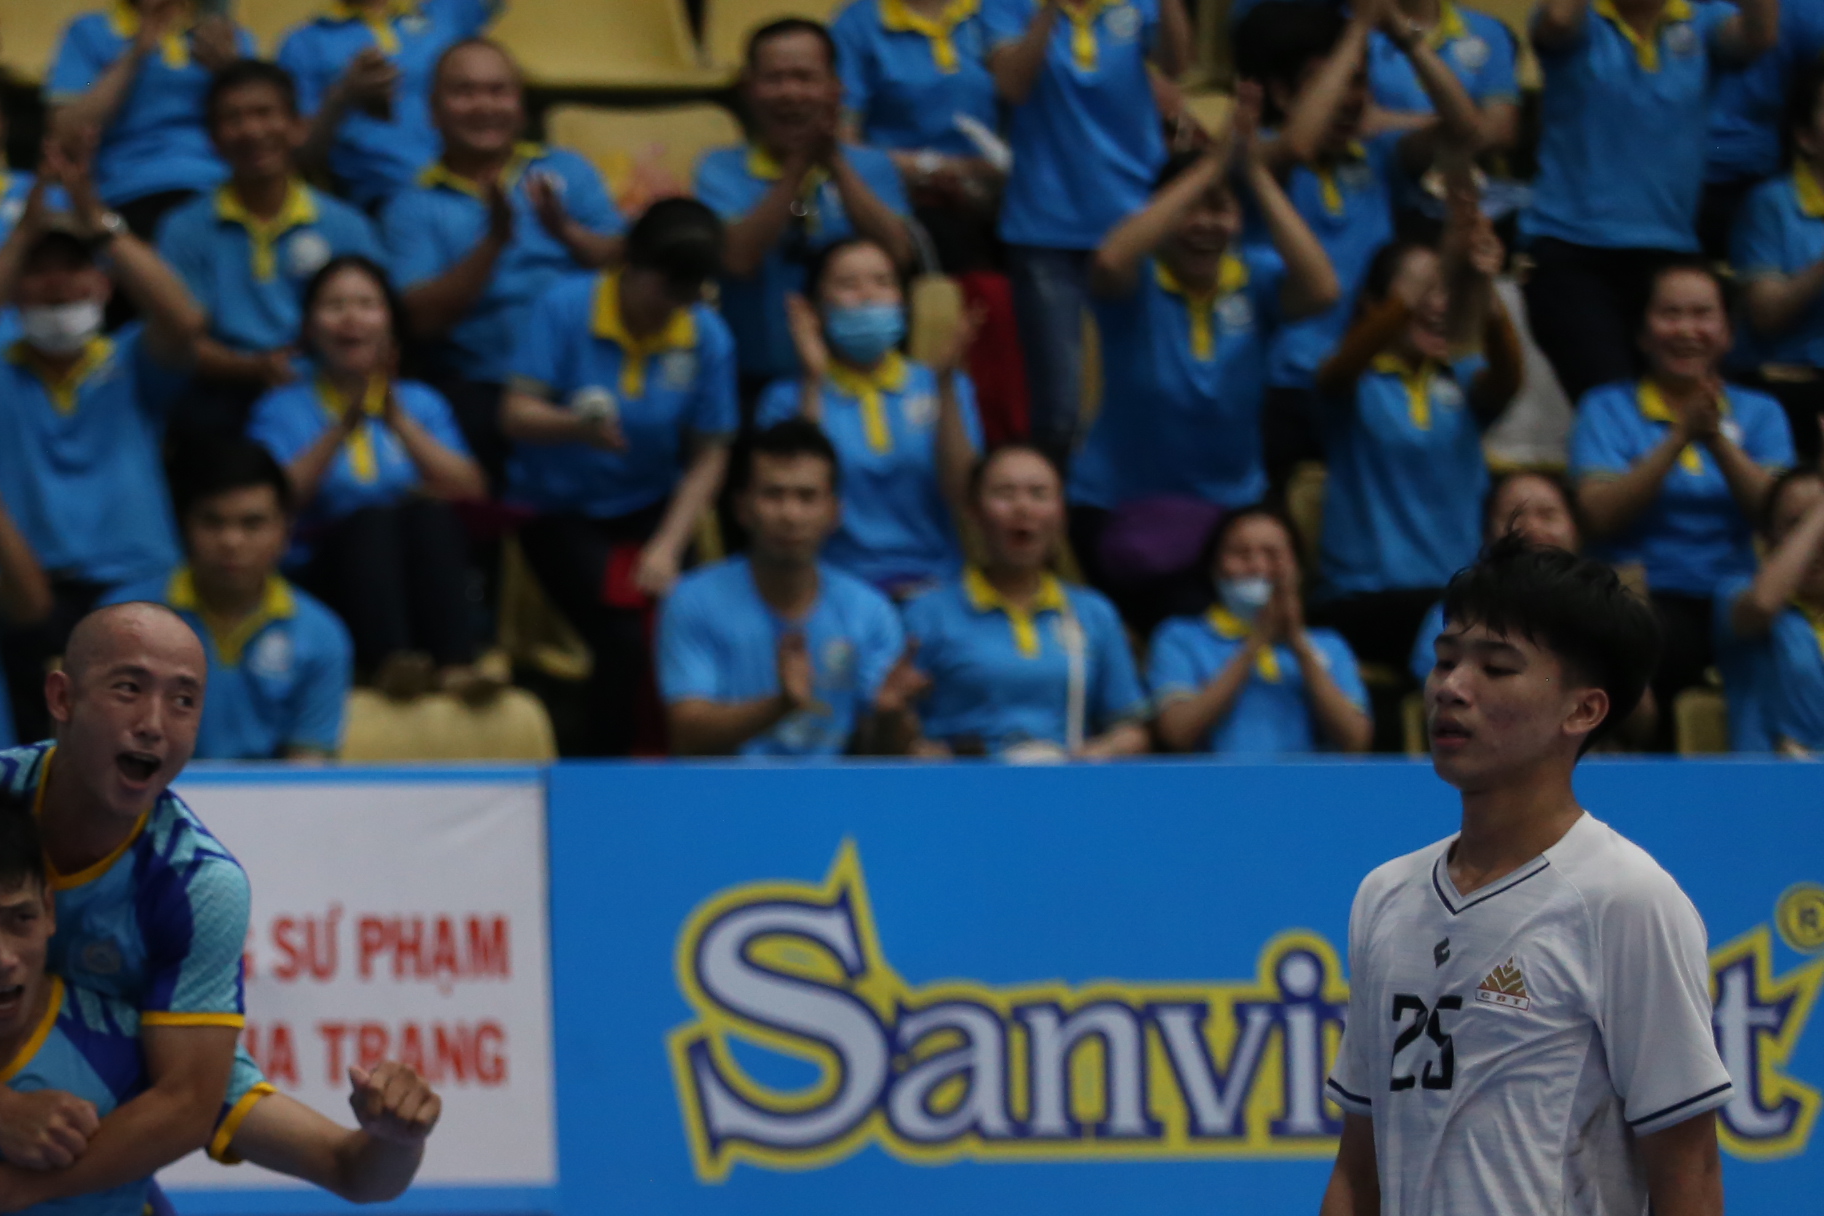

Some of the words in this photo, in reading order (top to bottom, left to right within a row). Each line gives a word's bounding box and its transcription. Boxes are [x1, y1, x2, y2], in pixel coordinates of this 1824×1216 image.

[356, 911, 510, 995] PHẠM
[314, 1017, 508, 1087] TRANG
[666, 835, 1824, 1185] Sanvit
[1389, 993, 1463, 1092] 25
